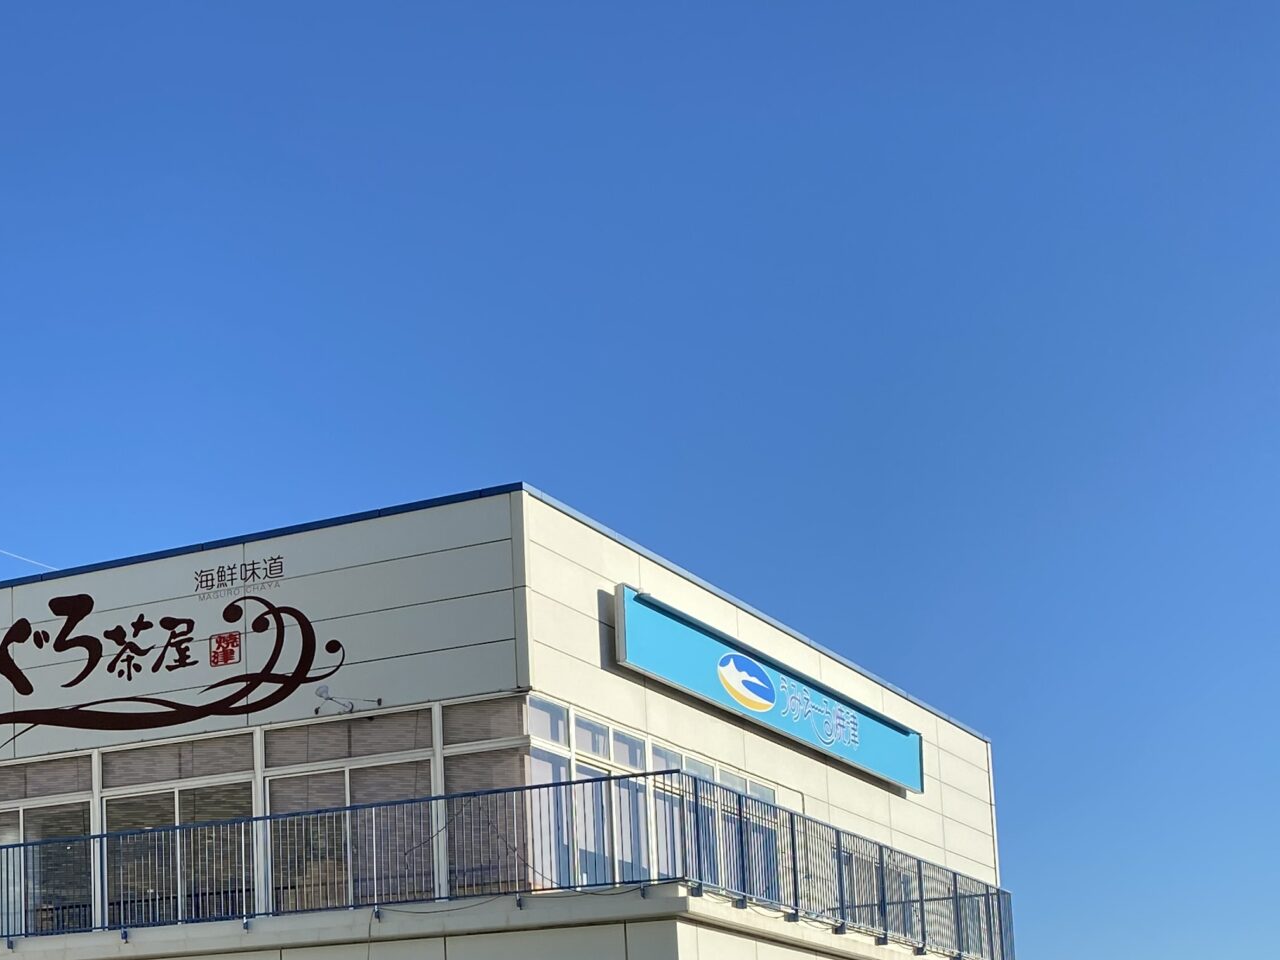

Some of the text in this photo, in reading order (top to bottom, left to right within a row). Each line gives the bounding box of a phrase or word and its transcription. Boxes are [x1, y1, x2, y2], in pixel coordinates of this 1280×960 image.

[194, 556, 285, 592] 海鮮味道
[198, 581, 281, 602] MAGURO CHAYA
